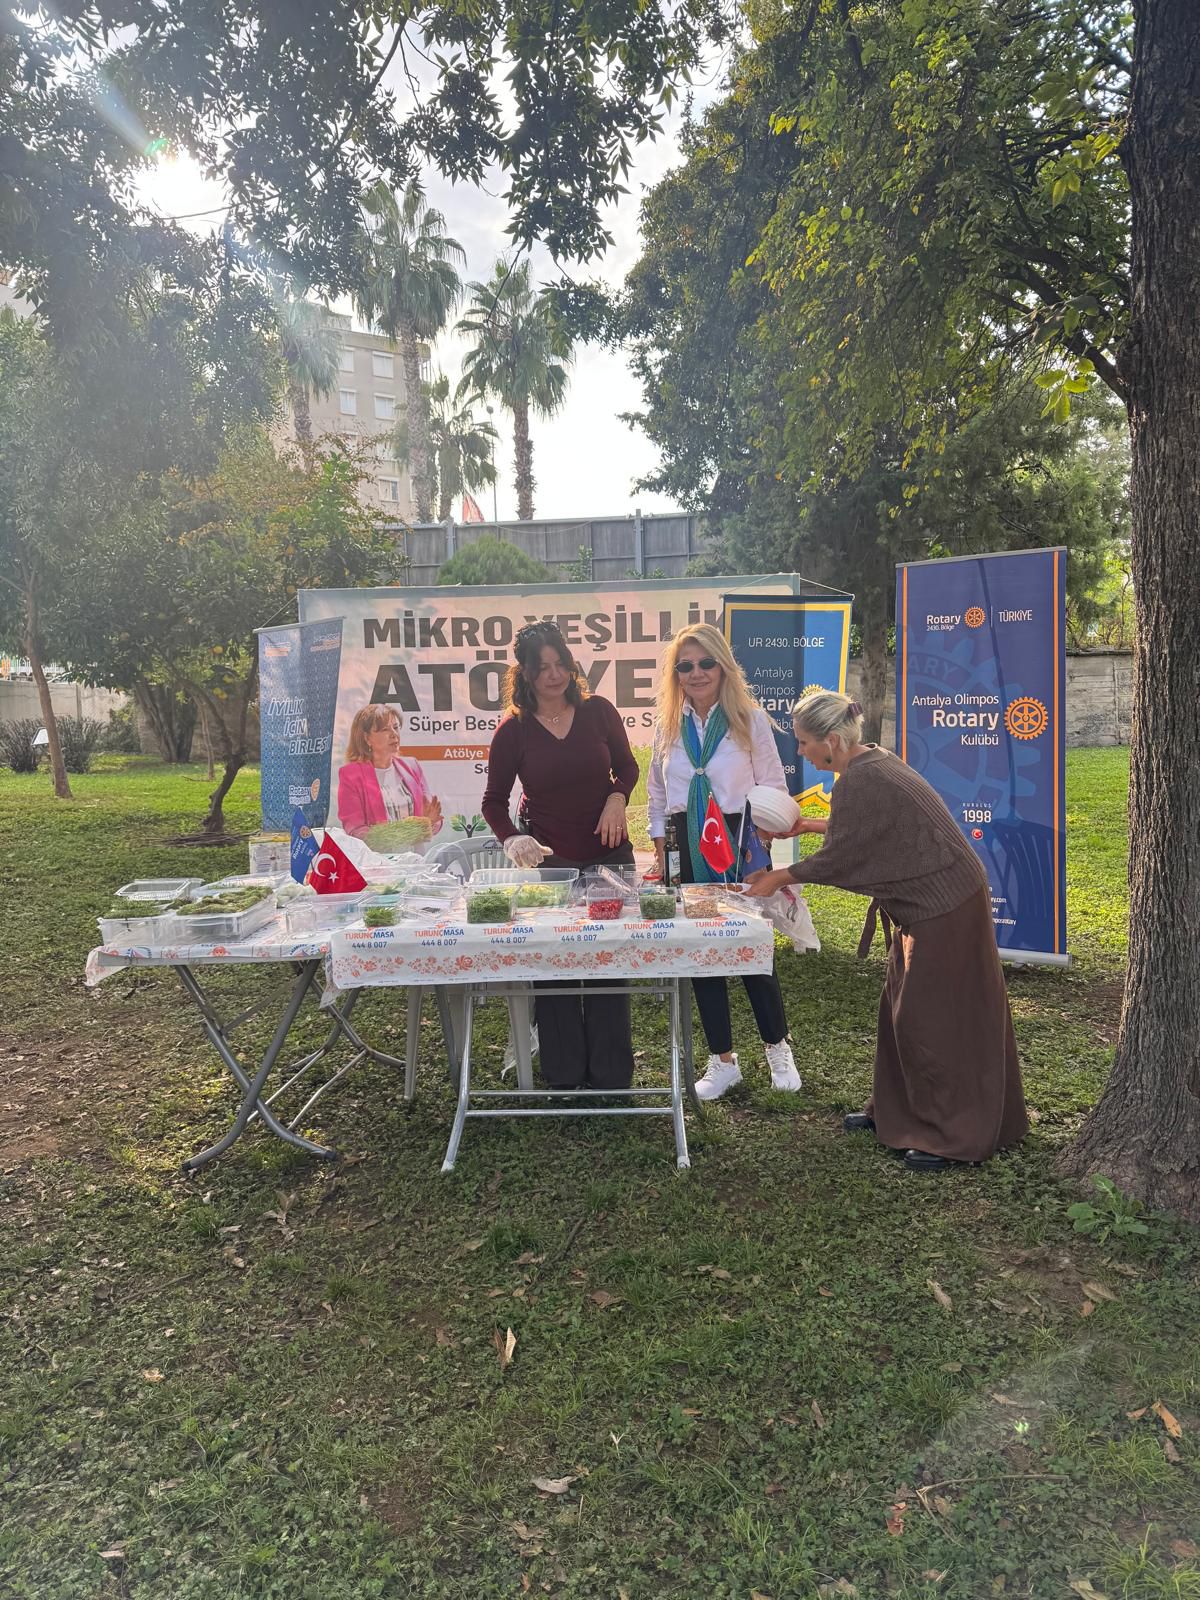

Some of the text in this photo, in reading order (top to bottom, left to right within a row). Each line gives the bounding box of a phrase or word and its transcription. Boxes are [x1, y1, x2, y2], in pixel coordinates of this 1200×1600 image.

[926, 609, 1033, 625] Rotary TÜRKİYE
[363, 610, 513, 649] MİKRO
[748, 636, 825, 648] UR 2430. BÖLGE
[753, 667, 794, 681] Antalya
[752, 684, 796, 698] Olimpos
[758, 696, 796, 715] tary
[911, 693, 1000, 708] Antalya Olimpos
[409, 715, 460, 734] Süper
[932, 709, 1000, 731] Rotary
[960, 733, 1000, 746] Kulübü
[444, 748, 485, 760] Atölye
[962, 809, 992, 823] 1998
[576, 934, 582, 942] 8
[583, 934, 598, 942] 007
[630, 932, 645, 940] 444
[653, 931, 668, 939] 007
[725, 929, 740, 937] 007
[373, 941, 388, 949] 007
[421, 939, 436, 947] 444
[443, 938, 458, 946] 007
[513, 936, 527, 944] 007
